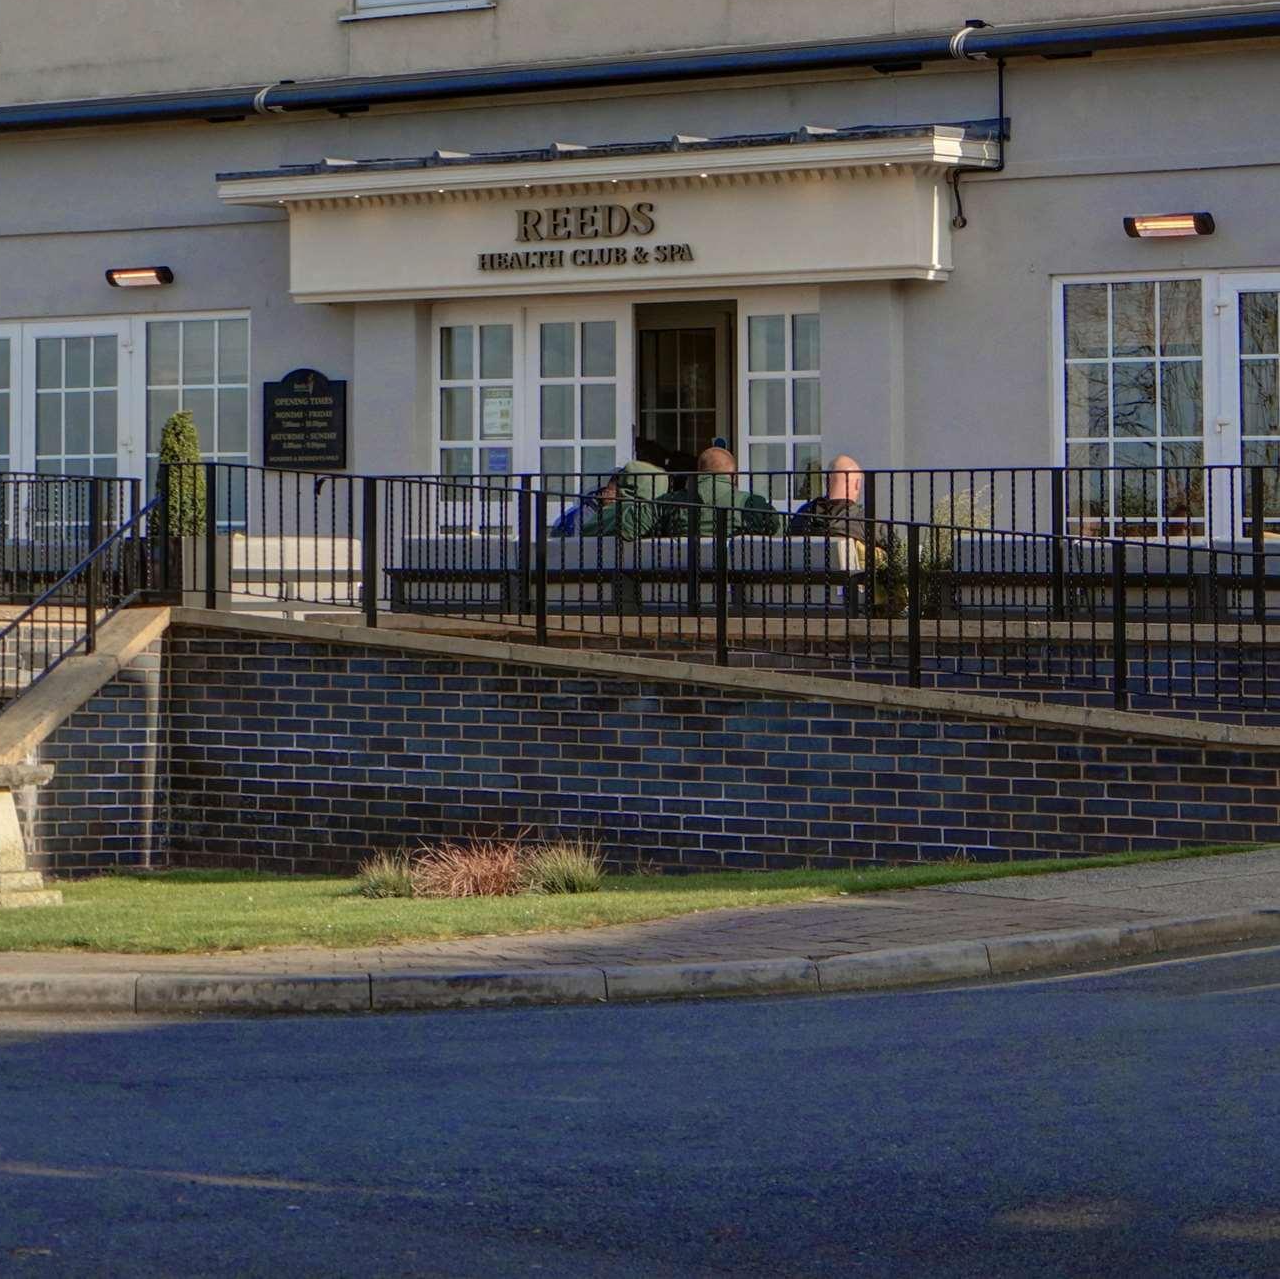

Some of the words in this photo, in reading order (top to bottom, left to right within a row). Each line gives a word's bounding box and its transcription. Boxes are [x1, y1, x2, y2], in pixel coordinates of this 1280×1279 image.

[515, 202, 655, 242] REEDS
[477, 250, 564, 271] HEALTH
[570, 247, 628, 267] CLUB
[632, 246, 649, 264] &
[654, 243, 694, 263] SPA
[275, 398, 308, 406] OPENING
